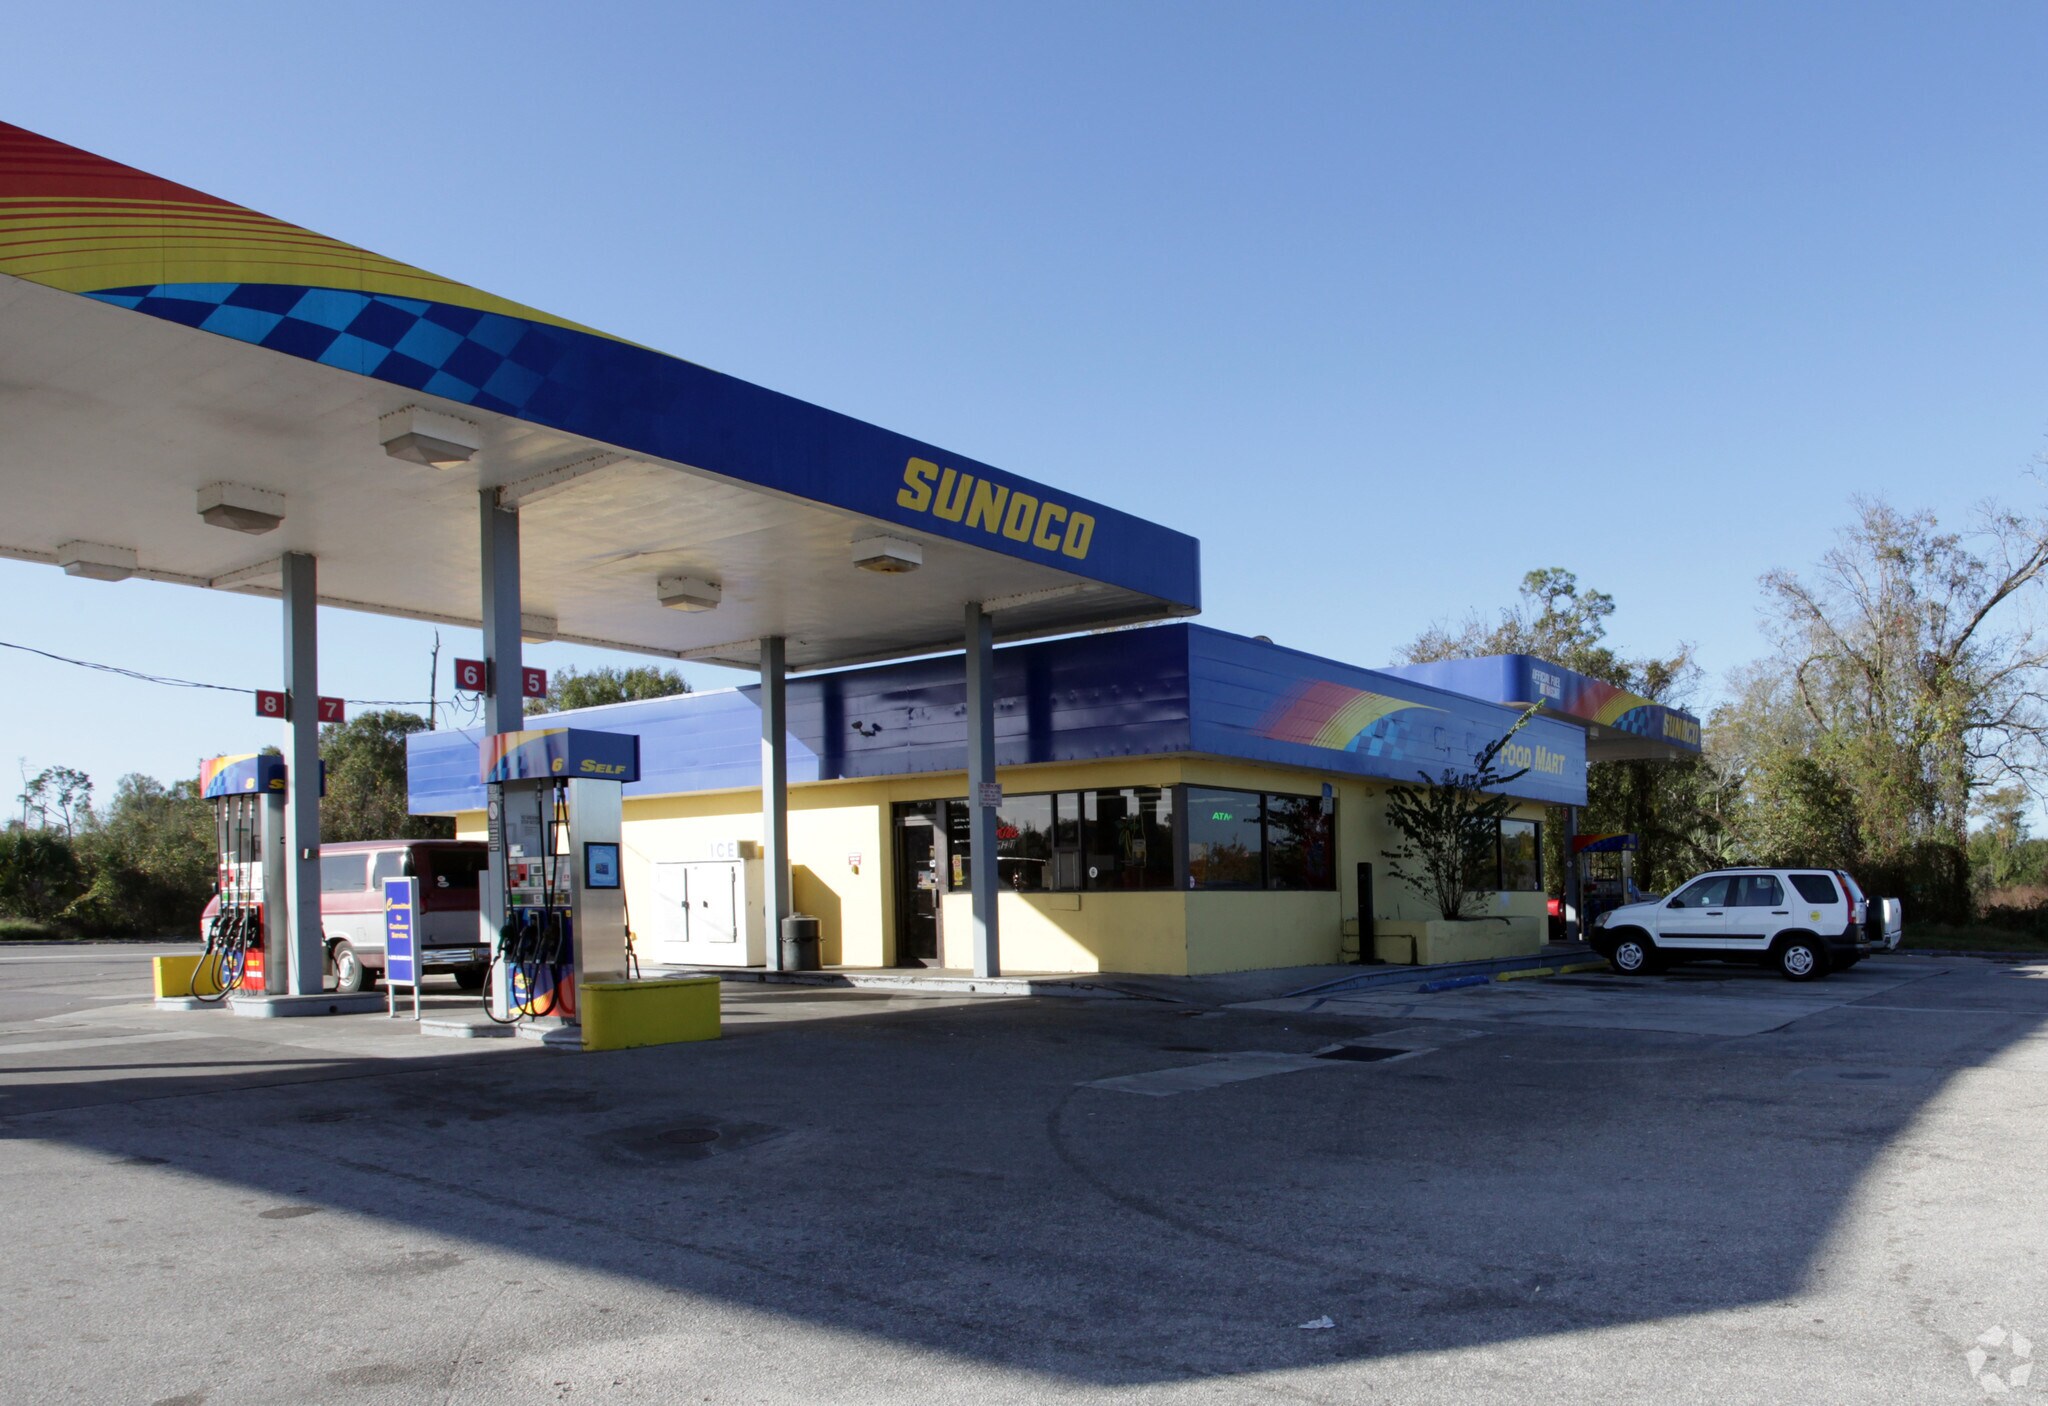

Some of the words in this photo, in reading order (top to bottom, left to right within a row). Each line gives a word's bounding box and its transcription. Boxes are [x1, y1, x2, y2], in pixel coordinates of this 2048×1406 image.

[896, 456, 1096, 560] SUNOCO
[464, 665, 478, 685] 6
[528, 673, 540, 692] 5
[264, 696, 277, 712] 8
[325, 702, 337, 718] 7
[1663, 713, 1699, 745] SUNOCO
[551, 757, 563, 772] 6
[1501, 740, 1532, 769] FOOD
[1535, 745, 1566, 775] MART
[580, 759, 627, 774] SELF
[245, 777, 255, 789] 8
[1212, 811, 1232, 821] ATM
[710, 842, 735, 858] ICE
